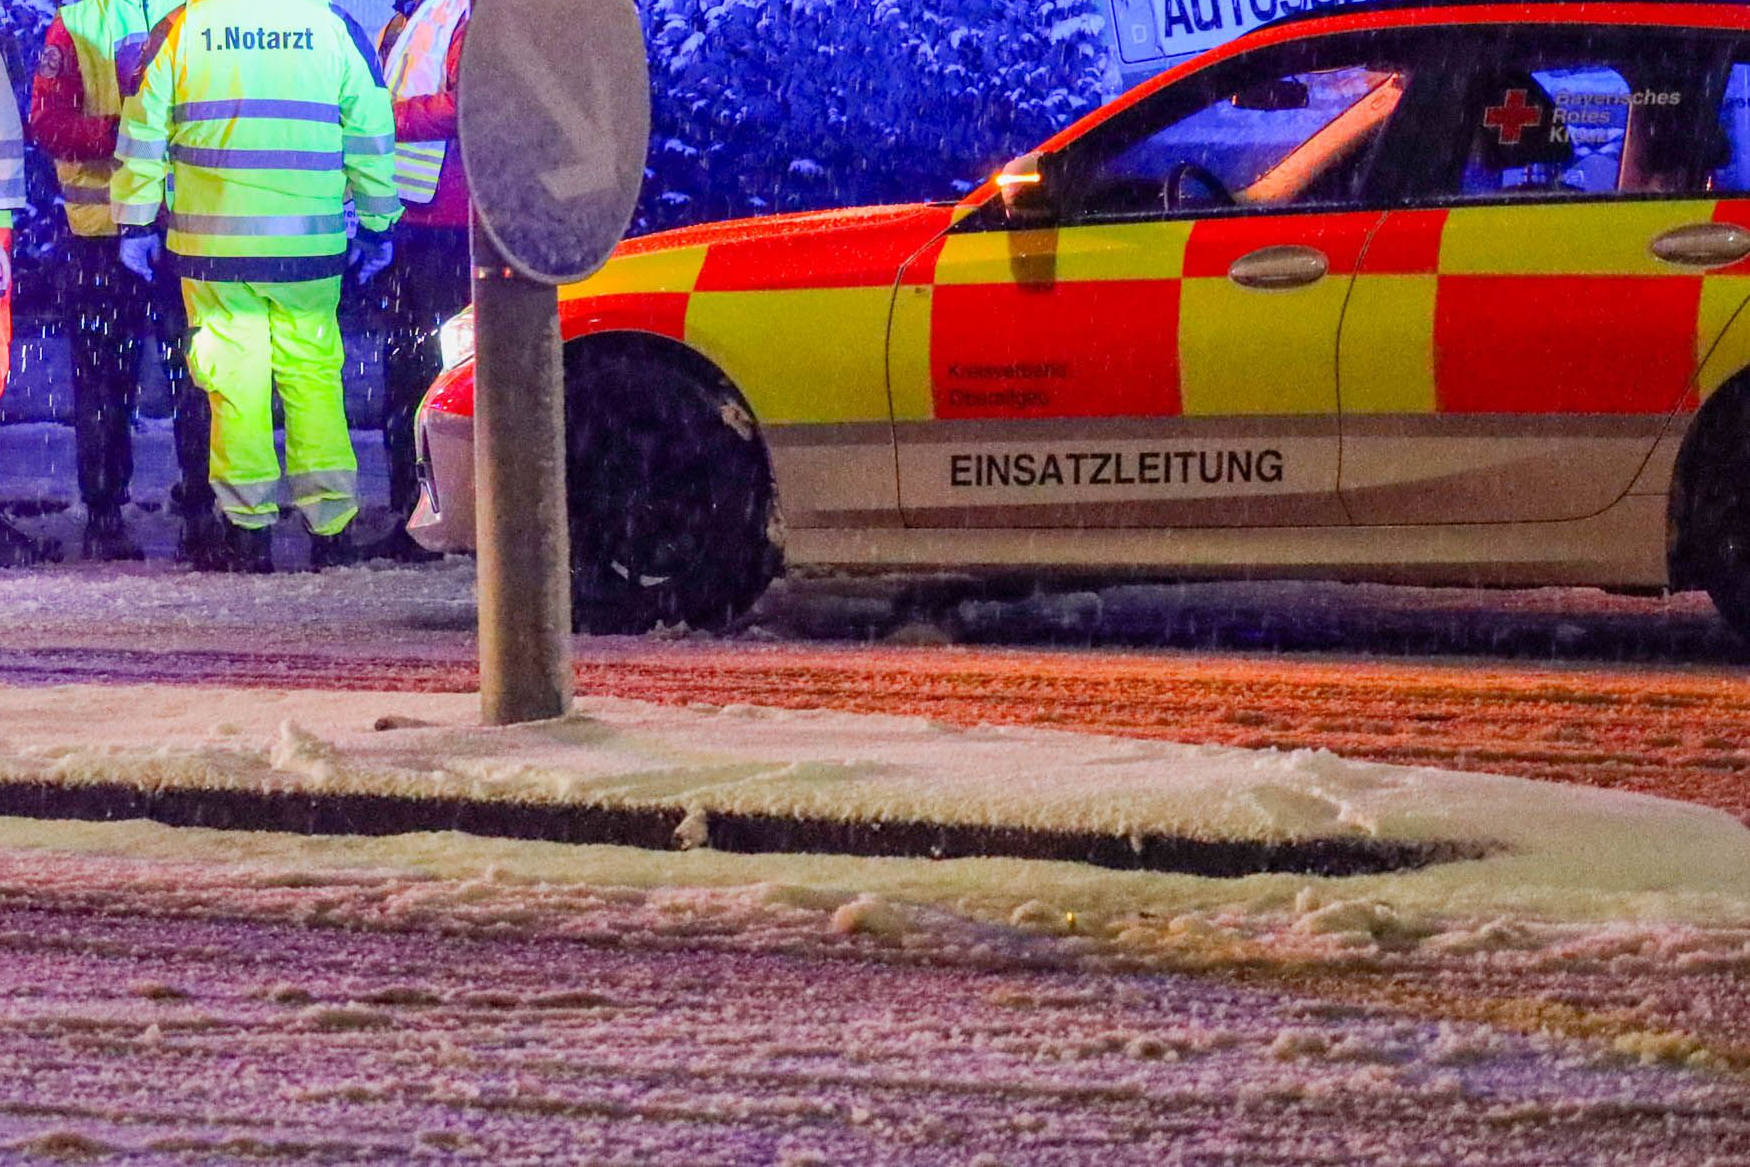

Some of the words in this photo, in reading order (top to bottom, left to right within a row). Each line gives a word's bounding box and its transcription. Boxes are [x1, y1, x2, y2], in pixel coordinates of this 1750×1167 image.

[201, 26, 314, 52] 1.Notarzt
[1555, 89, 1681, 107] Bayerisches
[1553, 108, 1610, 124] Rotes
[950, 449, 1284, 486] EINSATZLEITUNG
